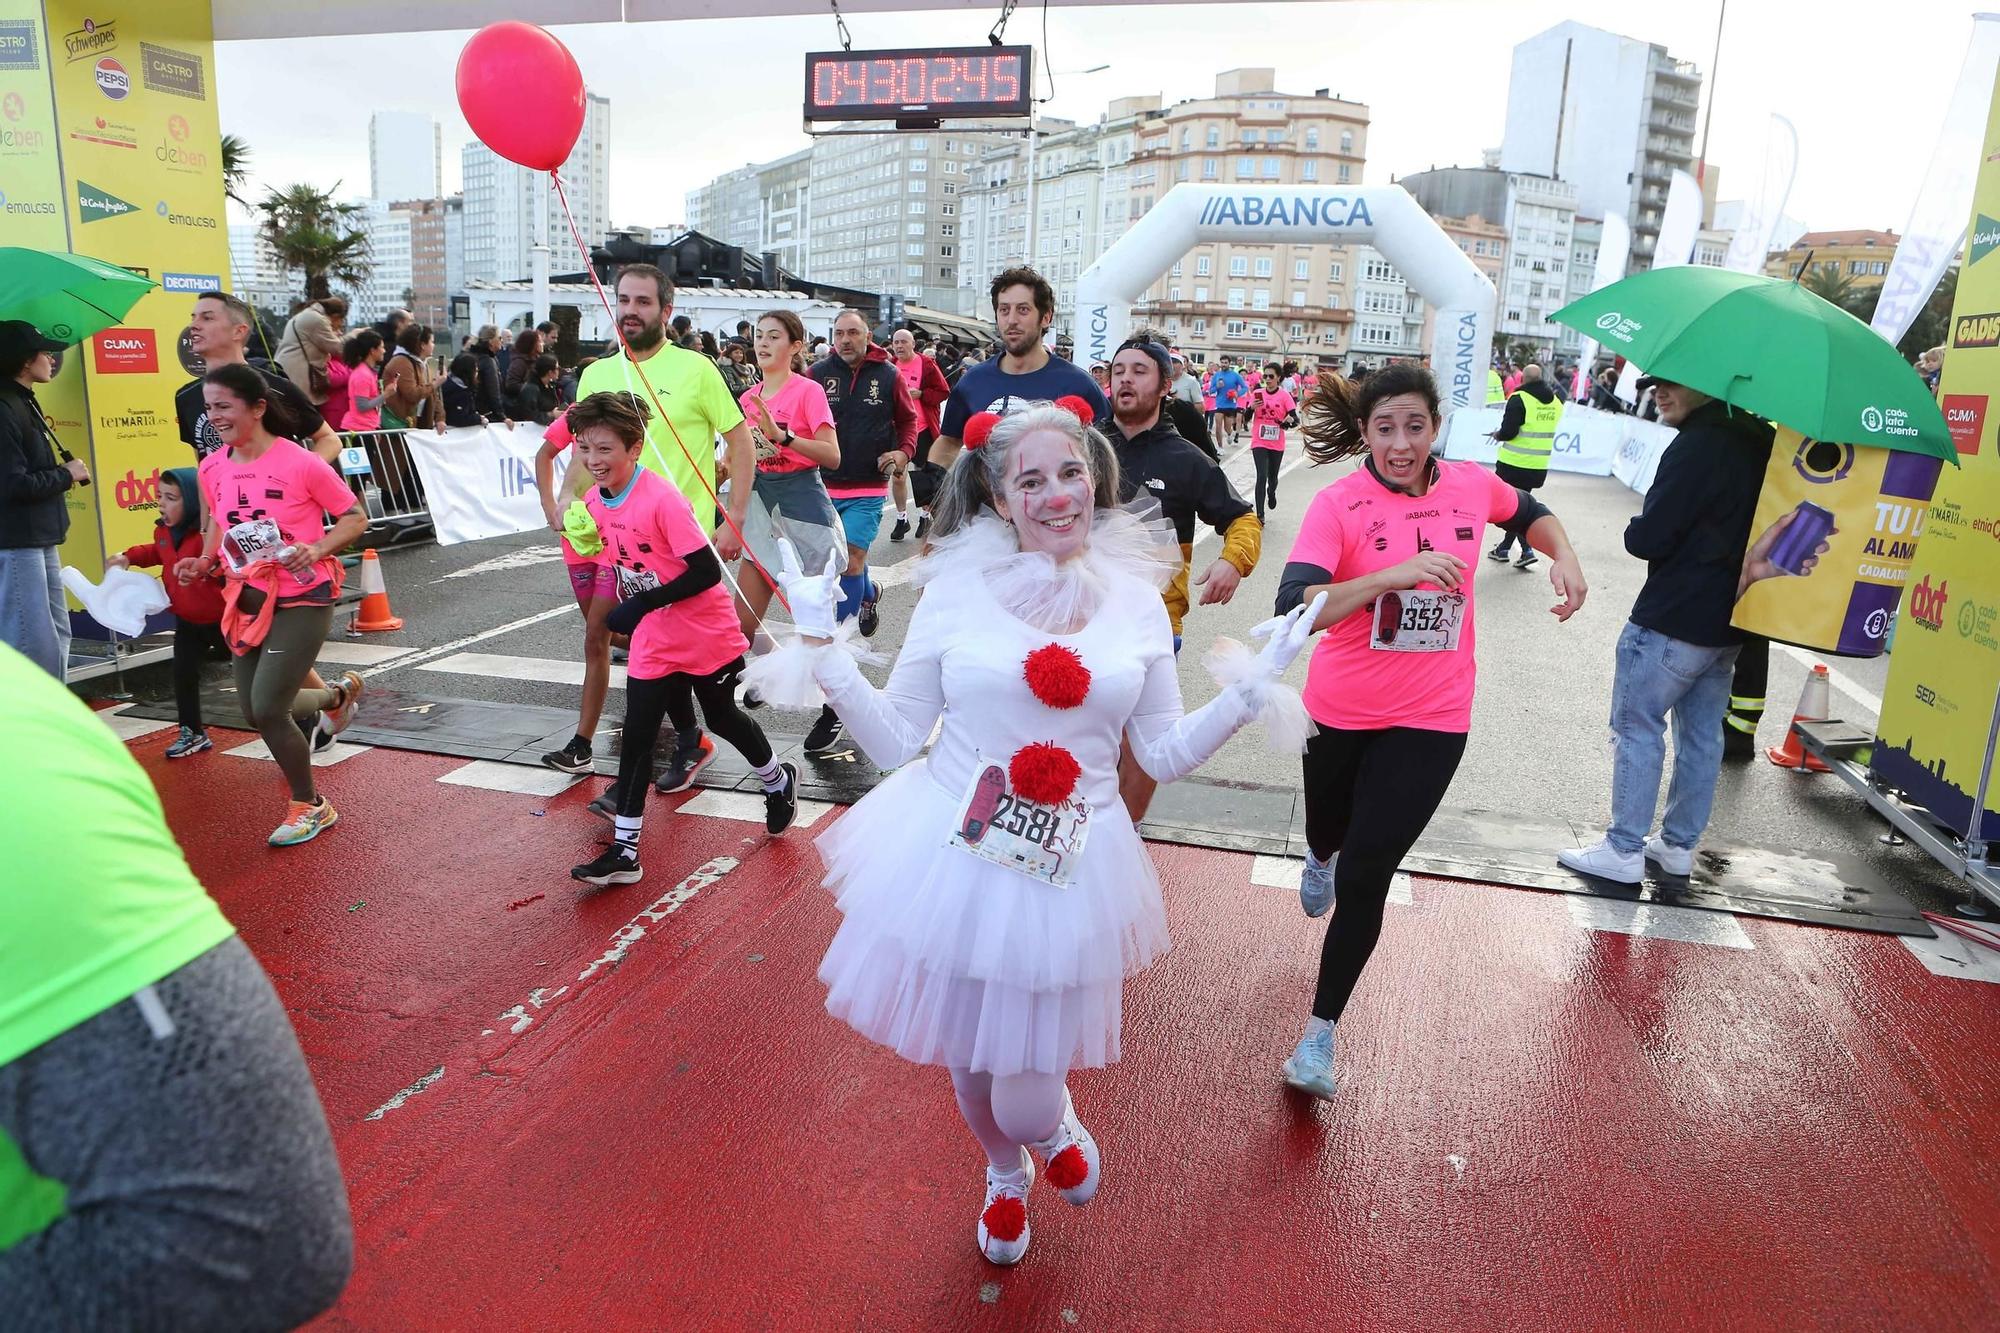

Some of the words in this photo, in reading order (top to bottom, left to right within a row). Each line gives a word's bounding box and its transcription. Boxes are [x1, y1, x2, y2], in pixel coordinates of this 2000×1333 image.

[0, 36, 26, 47] STRO
[64, 28, 116, 60] Schweppes
[153, 60, 192, 79] CASTRO
[97, 71, 129, 88] PEPSI
[0, 128, 44, 147] eben
[156, 137, 207, 168] deben
[6, 202, 56, 214] emalcsa
[89, 198, 105, 208] Corte
[168, 213, 217, 228] emalcsa
[165, 275, 219, 292] DECATHLON
[1957, 316, 2000, 344] GADIS
[826, 379, 837, 394] 2
[1885, 408, 1908, 418] cada
[1885, 416, 1905, 426] lata
[1886, 427, 1919, 437] cuenta
[1875, 502, 1912, 535] TU
[237, 534, 263, 554] 615
[1863, 537, 1885, 557] AL
[1910, 574, 1948, 629] dxt
[989, 792, 1061, 849] 2581
